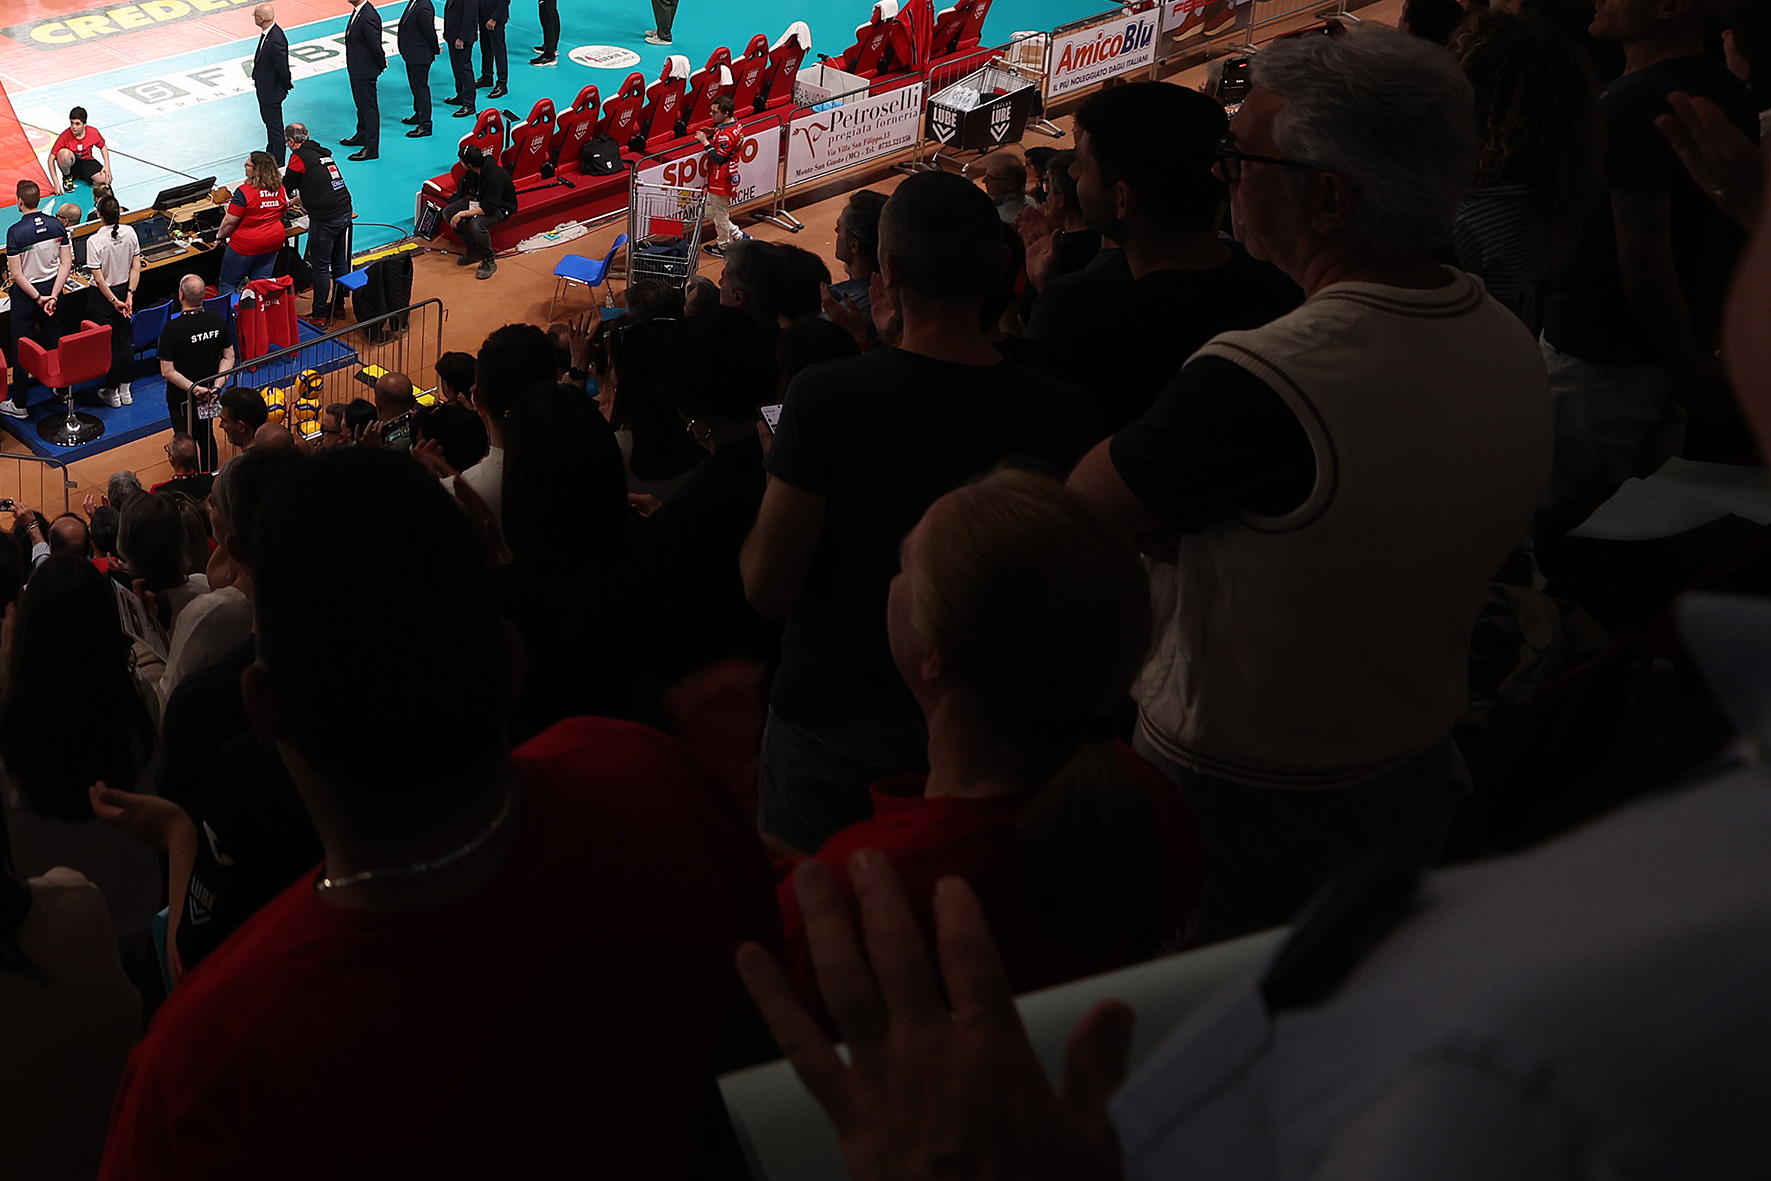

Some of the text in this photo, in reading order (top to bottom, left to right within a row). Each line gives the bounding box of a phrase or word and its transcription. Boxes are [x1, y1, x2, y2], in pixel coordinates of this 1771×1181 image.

[1055, 20, 1154, 76] AmicoBlu
[1070, 54, 1149, 86] NOLEGGIATO ITALIANI
[829, 86, 919, 132] Petroselli
[933, 108, 957, 123] LUBE
[828, 110, 918, 147] pregiata forneria
[190, 329, 220, 345] STAFF
